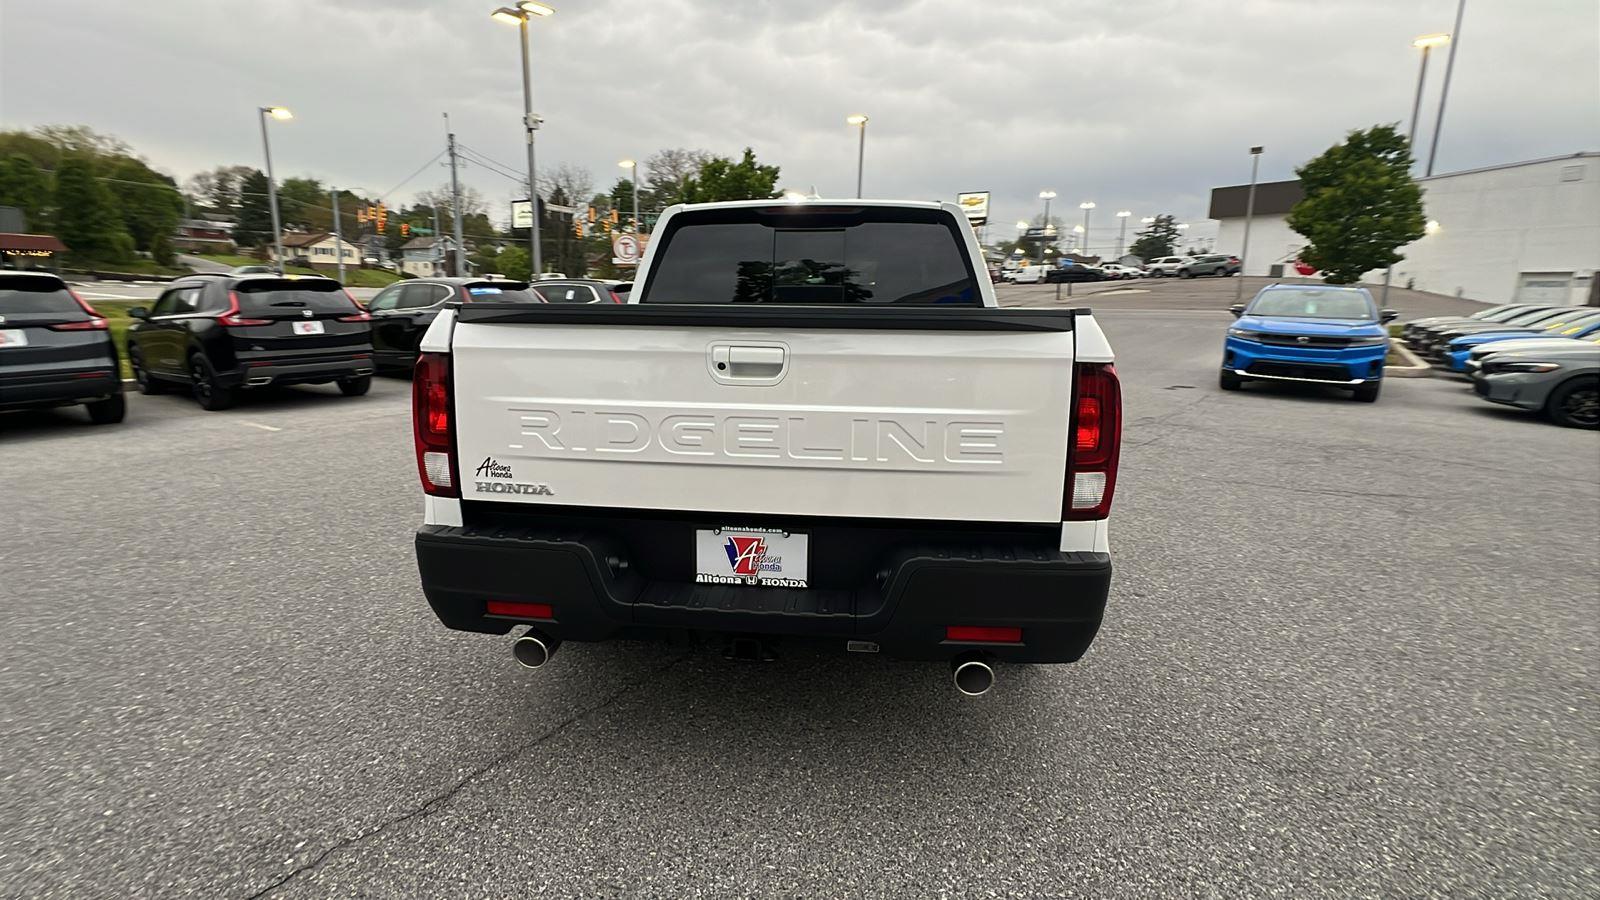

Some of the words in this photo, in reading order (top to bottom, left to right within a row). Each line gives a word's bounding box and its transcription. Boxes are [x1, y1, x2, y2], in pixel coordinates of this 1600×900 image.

[507, 407, 1004, 464] RIDGELINE
[476, 456, 512, 477] Altoona
[491, 471, 512, 479] Honda
[475, 481, 555, 496] HONDA
[721, 525, 783, 533] altoonahonda.com
[752, 562, 782, 571] Honda
[695, 574, 742, 584] Altoona
[761, 578, 808, 588] HONDA
